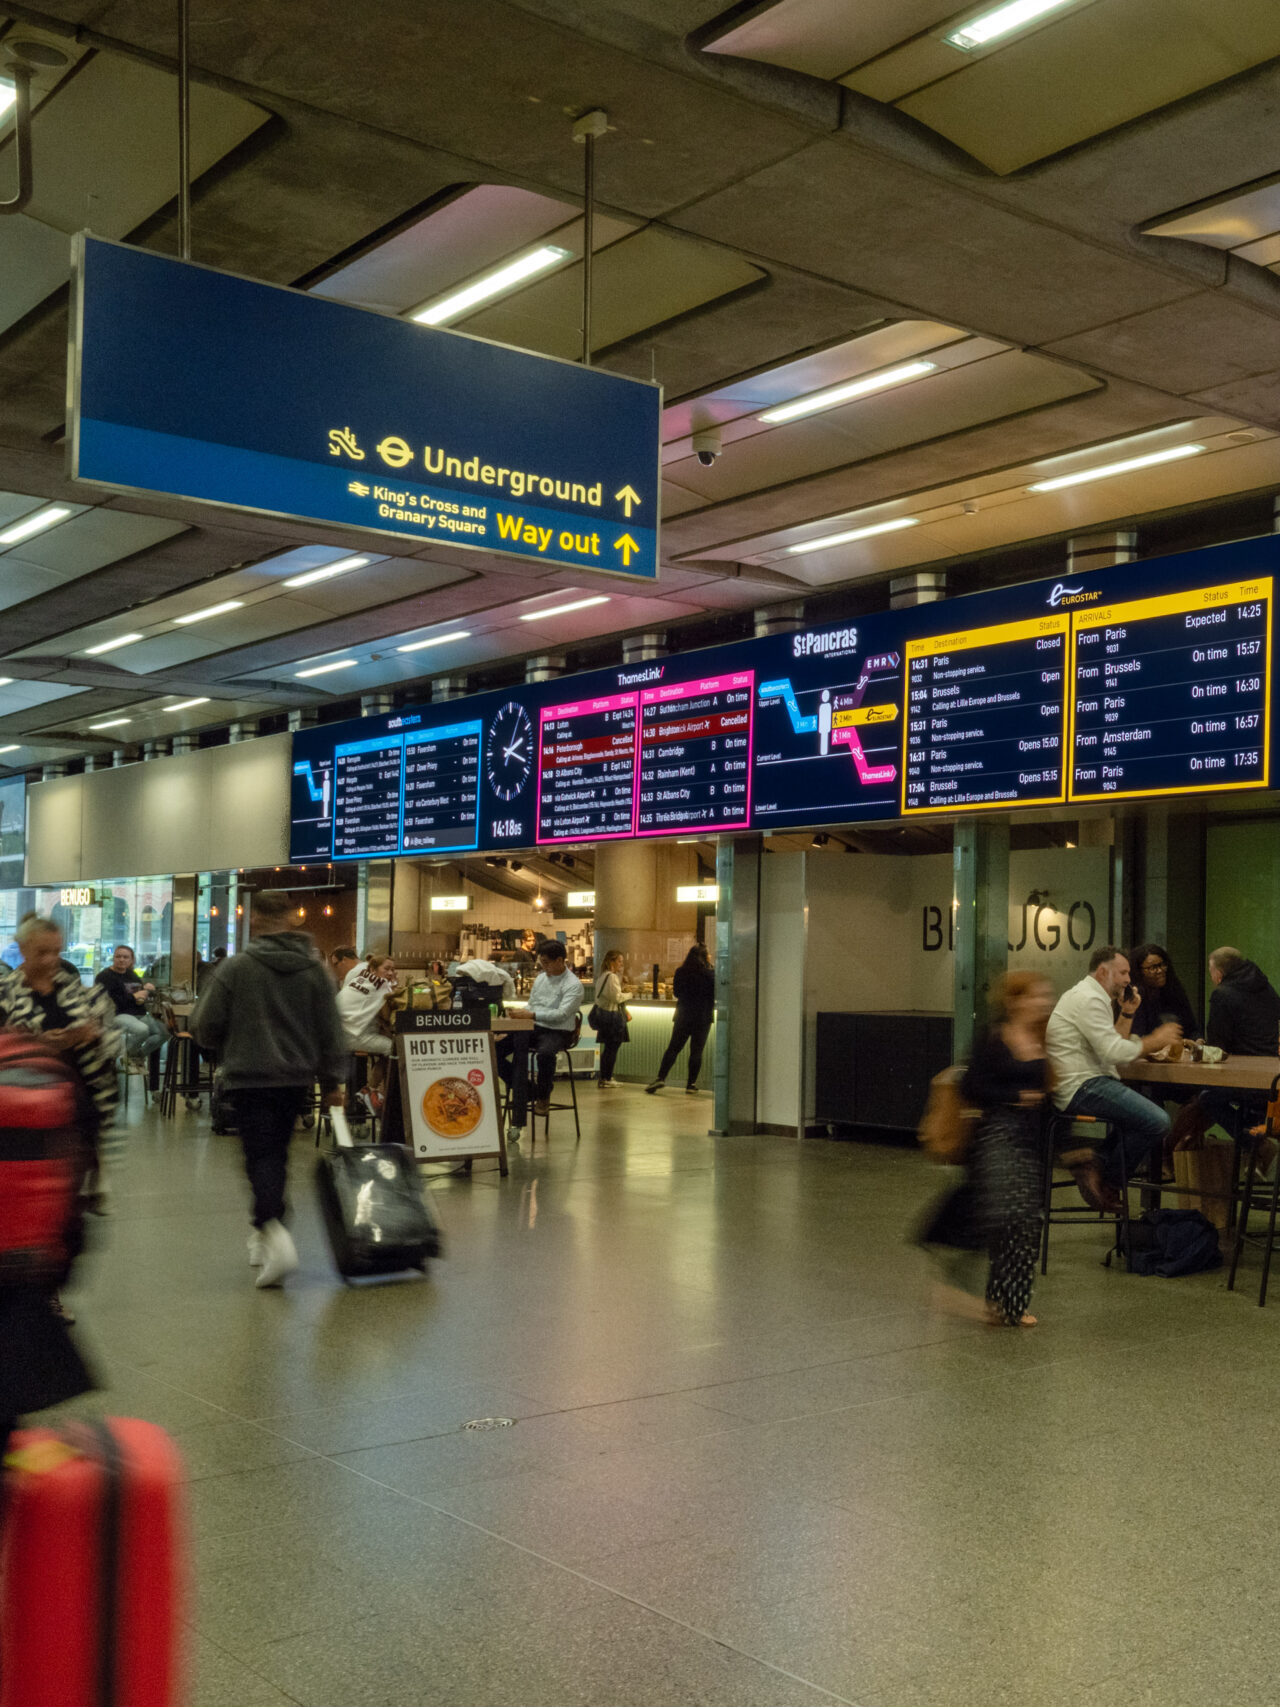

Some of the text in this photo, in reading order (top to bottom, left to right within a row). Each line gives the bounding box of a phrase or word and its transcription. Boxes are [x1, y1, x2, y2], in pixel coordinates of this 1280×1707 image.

[424, 446, 602, 507] Underground
[373, 485, 487, 519] King's Cross and
[379, 505, 486, 535] Granary Square
[496, 513, 600, 556] Way out
[1061, 592, 1098, 606] EUROSTAR
[1078, 585, 1259, 623] ARRIVALS Status Time
[1078, 604, 1261, 645] From Paris Expected 14:25
[912, 637, 1060, 670] 14:31 Paris Closed
[1078, 641, 1261, 679] From Brussels On time 15:57
[1077, 678, 1260, 712] From Paris On time 16:30
[720, 714, 747, 726] Cancelled
[1076, 715, 1259, 746] From Amsterdam On time 16:57
[1075, 752, 1258, 780] From Paris On time 17:35
[61, 888, 90, 906] BENUGO
[923, 901, 1095, 950] BUGO
[416, 1014, 471, 1026] BENUGO
[410, 1039, 484, 1055] HOT STUFF!
